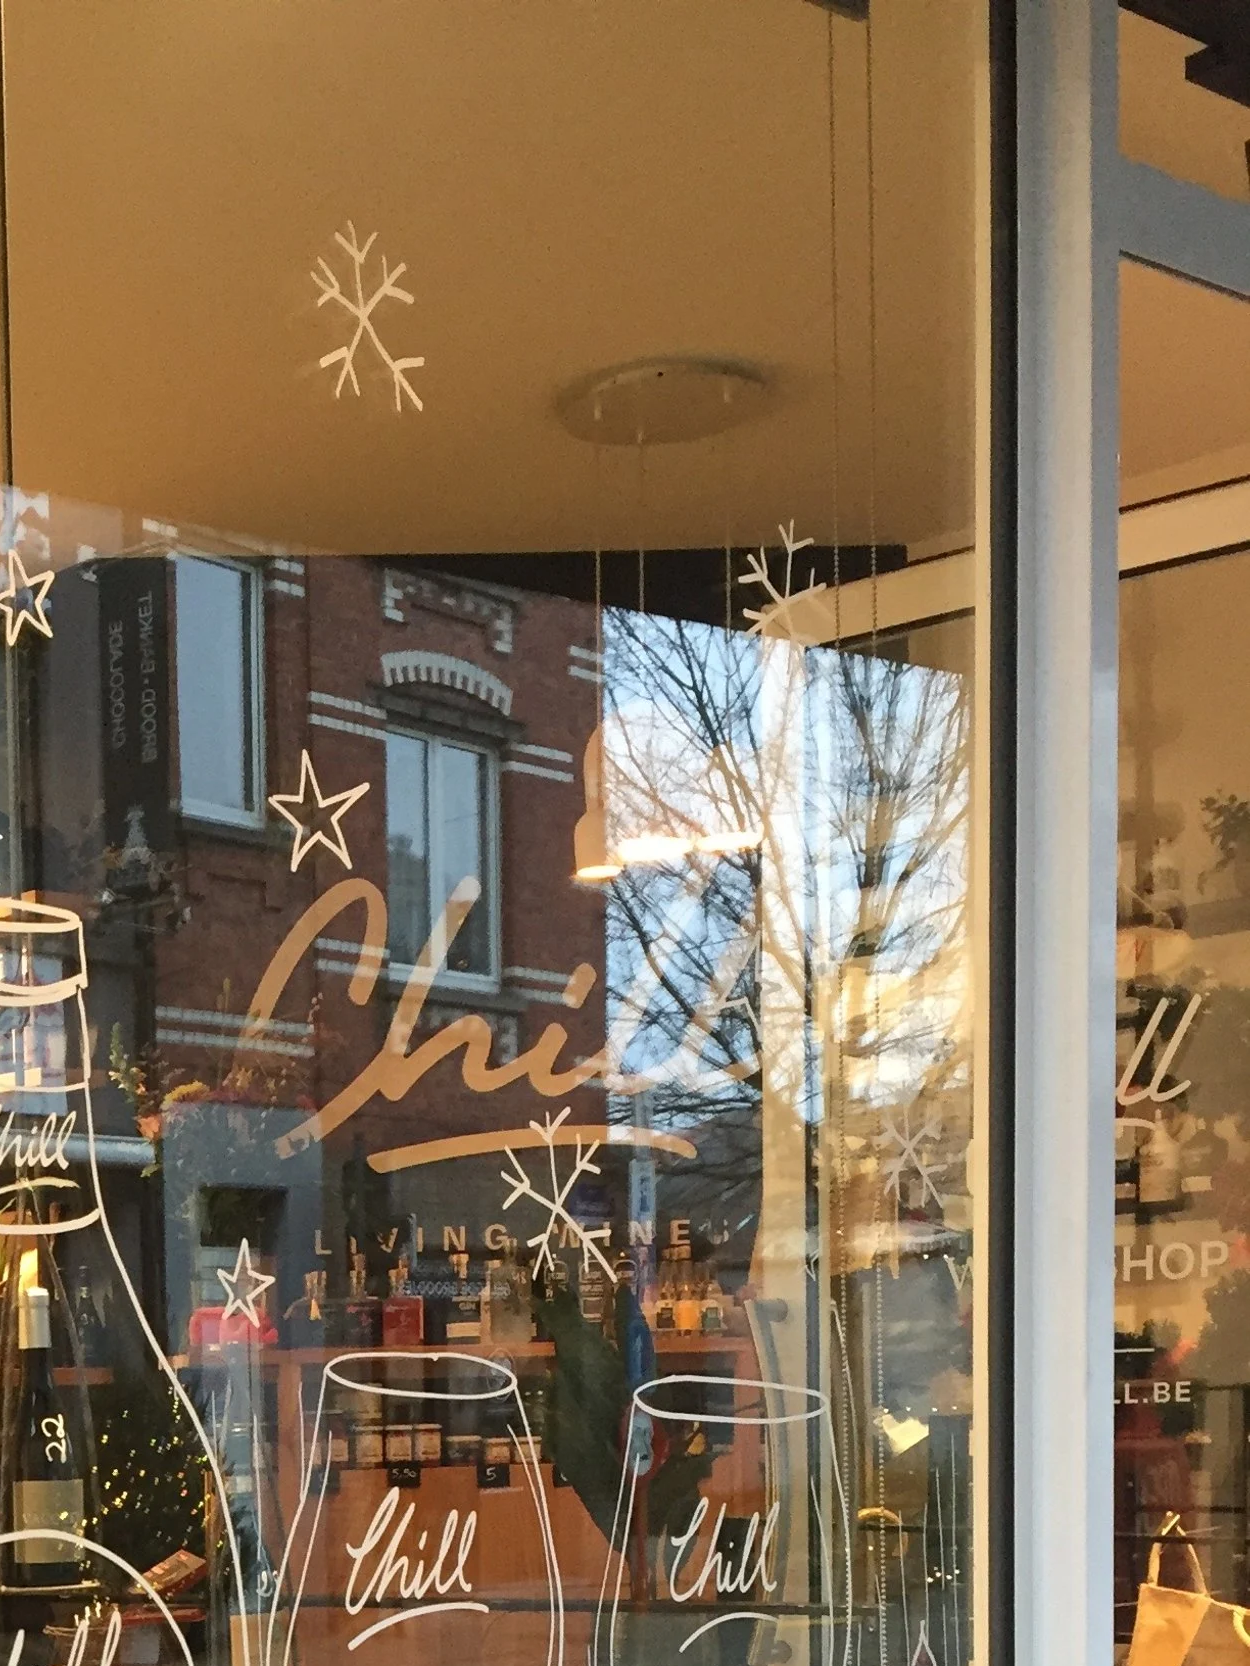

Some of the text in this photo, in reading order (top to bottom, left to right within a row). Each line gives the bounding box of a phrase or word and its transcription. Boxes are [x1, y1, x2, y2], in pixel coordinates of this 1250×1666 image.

[1116, 1239, 1229, 1281] HOP
[345, 1486, 479, 1616] Chill
[670, 1497, 781, 1603] Chill
